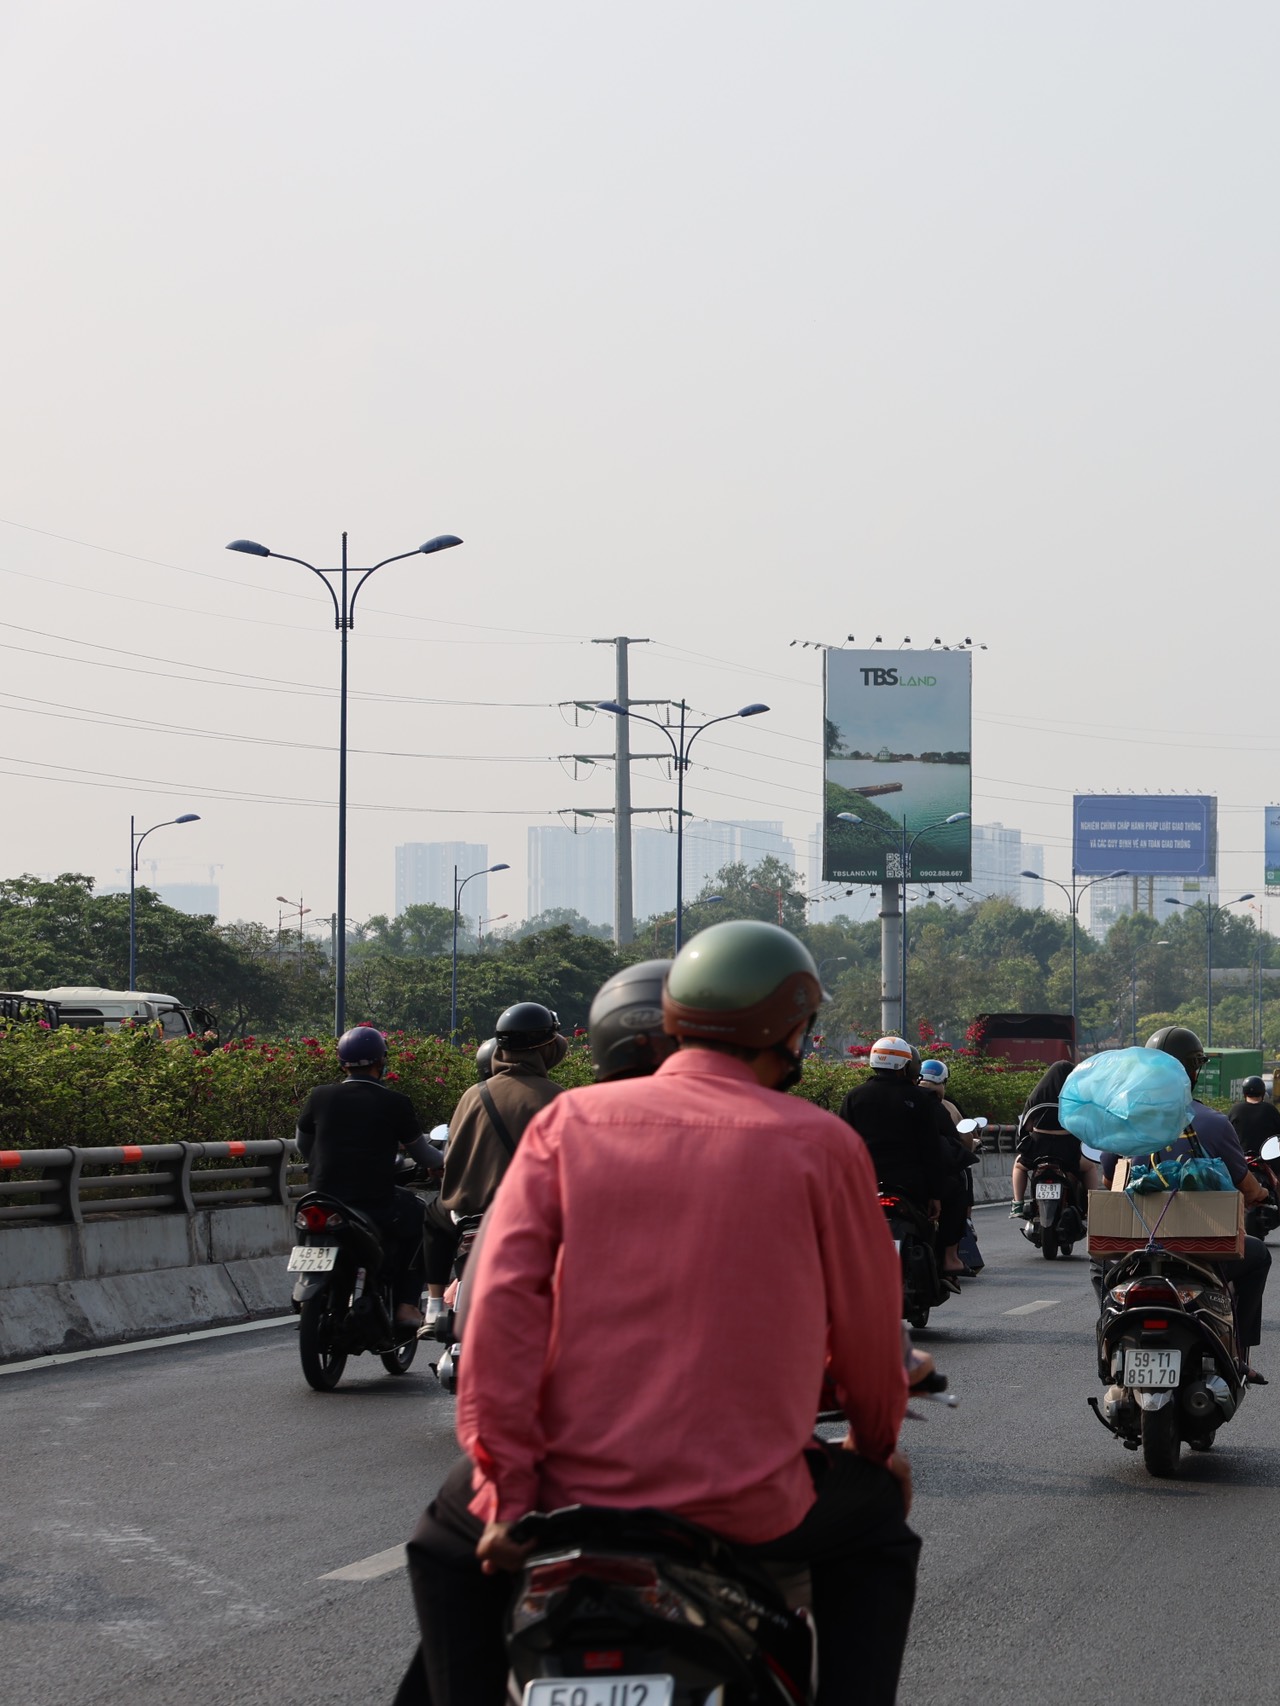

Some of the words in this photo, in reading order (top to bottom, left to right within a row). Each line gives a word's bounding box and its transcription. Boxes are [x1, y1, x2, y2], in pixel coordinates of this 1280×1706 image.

[859, 667, 898, 687] TBS
[899, 675, 937, 687] LAND
[291, 1259, 333, 1271] 477.47
[1134, 1352, 1171, 1368] 59-T1
[1128, 1368, 1176, 1385] 851.70
